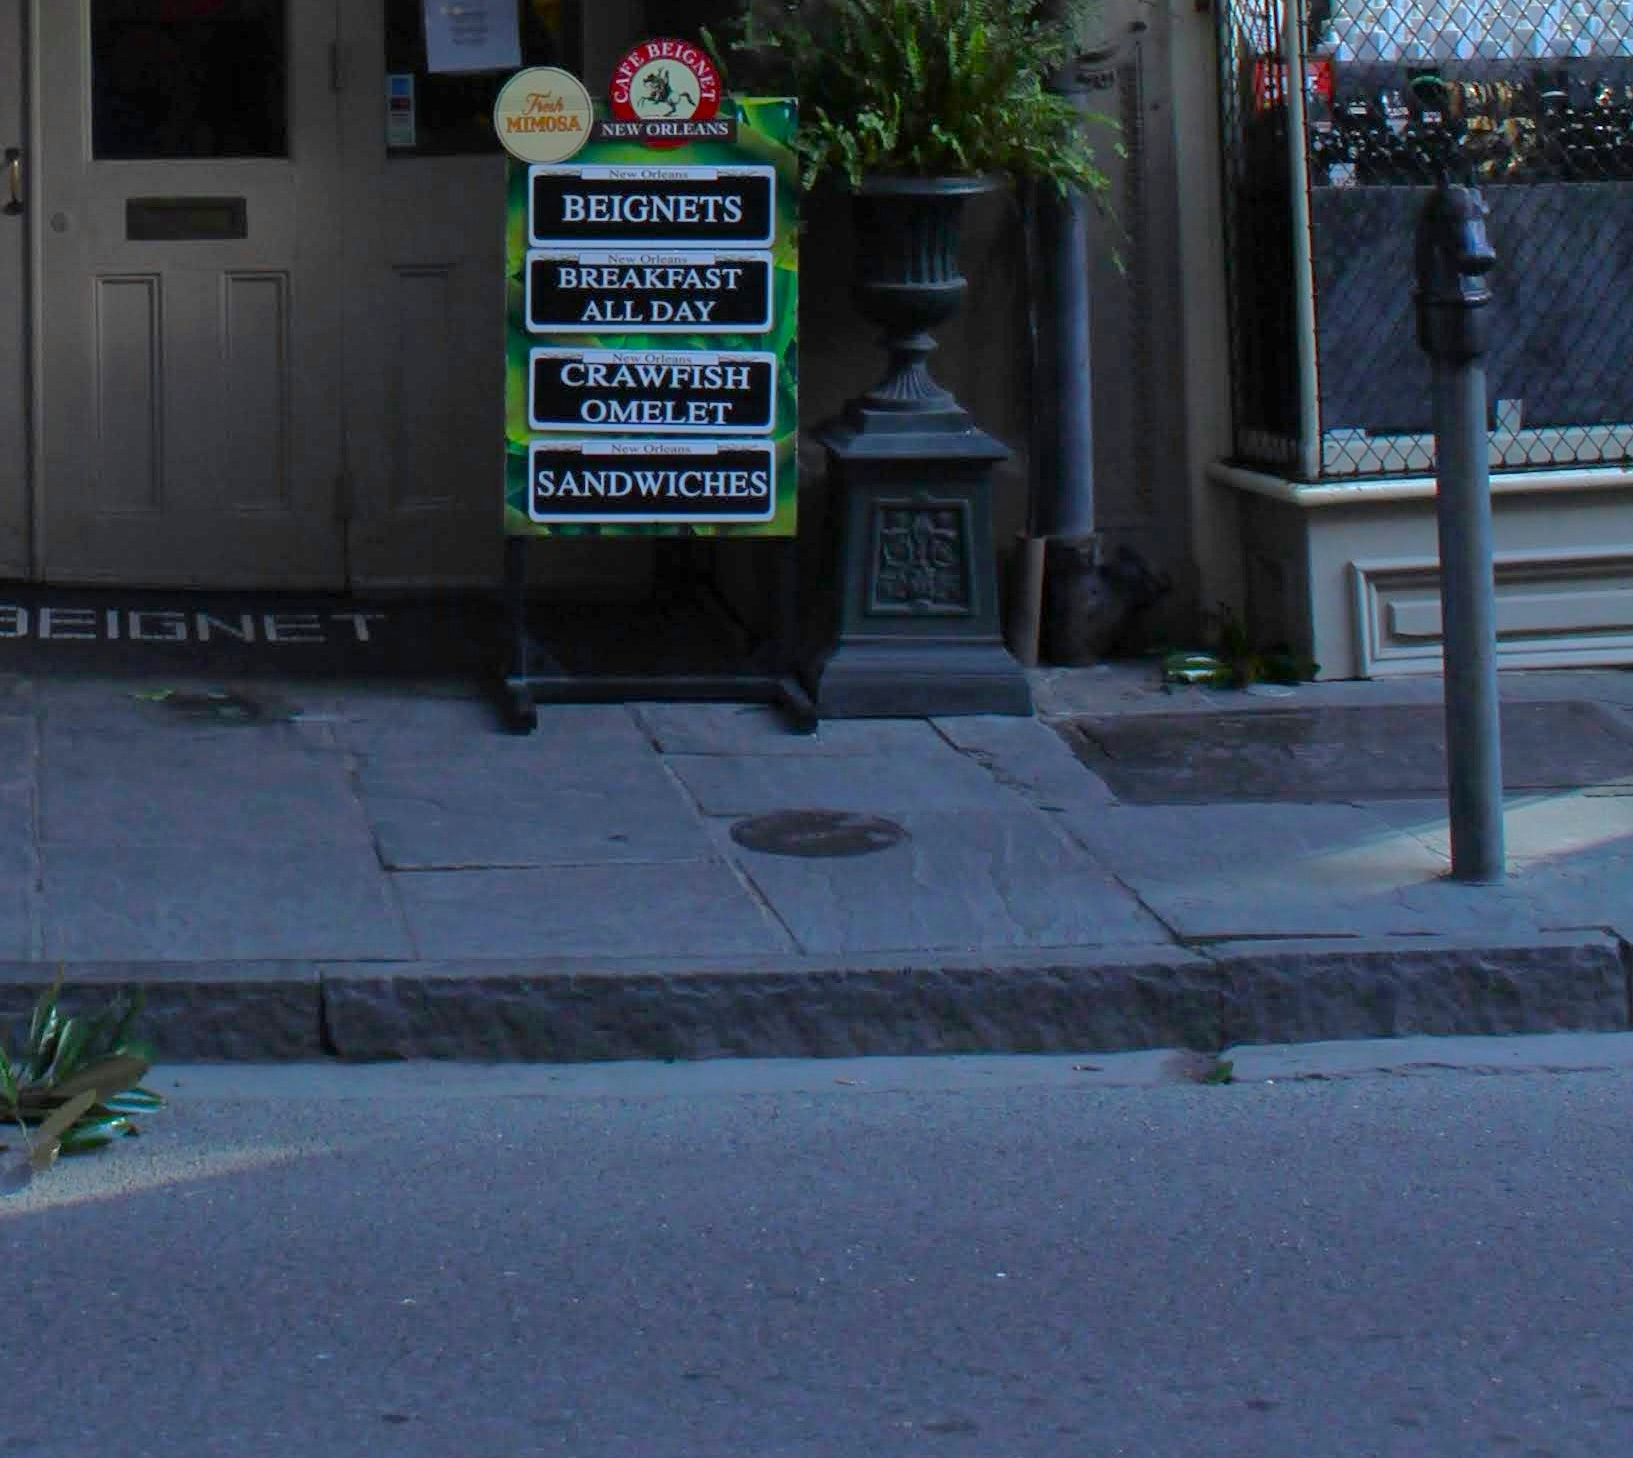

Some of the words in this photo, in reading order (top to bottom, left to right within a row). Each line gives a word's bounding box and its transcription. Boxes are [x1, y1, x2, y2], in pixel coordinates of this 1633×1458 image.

[613, 54, 645, 104] CAFE
[647, 42, 716, 103] BEIGNET
[523, 90, 564, 115] Fresh
[506, 116, 582, 133] MIMOSA
[602, 123, 643, 136] NEW
[646, 122, 729, 136] ORLEANS
[609, 170, 637, 179] New
[640, 169, 688, 179] Orleans
[562, 194, 743, 223] BEIGNETS
[608, 255, 636, 264] New
[639, 254, 687, 264] Orleans
[558, 267, 743, 290] BREAKFAST
[581, 300, 643, 322] ALL
[650, 300, 717, 322] DAY
[560, 363, 751, 390] CRAWFISH
[580, 399, 733, 425] OMELET
[611, 444, 639, 453] New
[642, 443, 690, 453] Orleans
[537, 470, 768, 498] SANDWICHES
